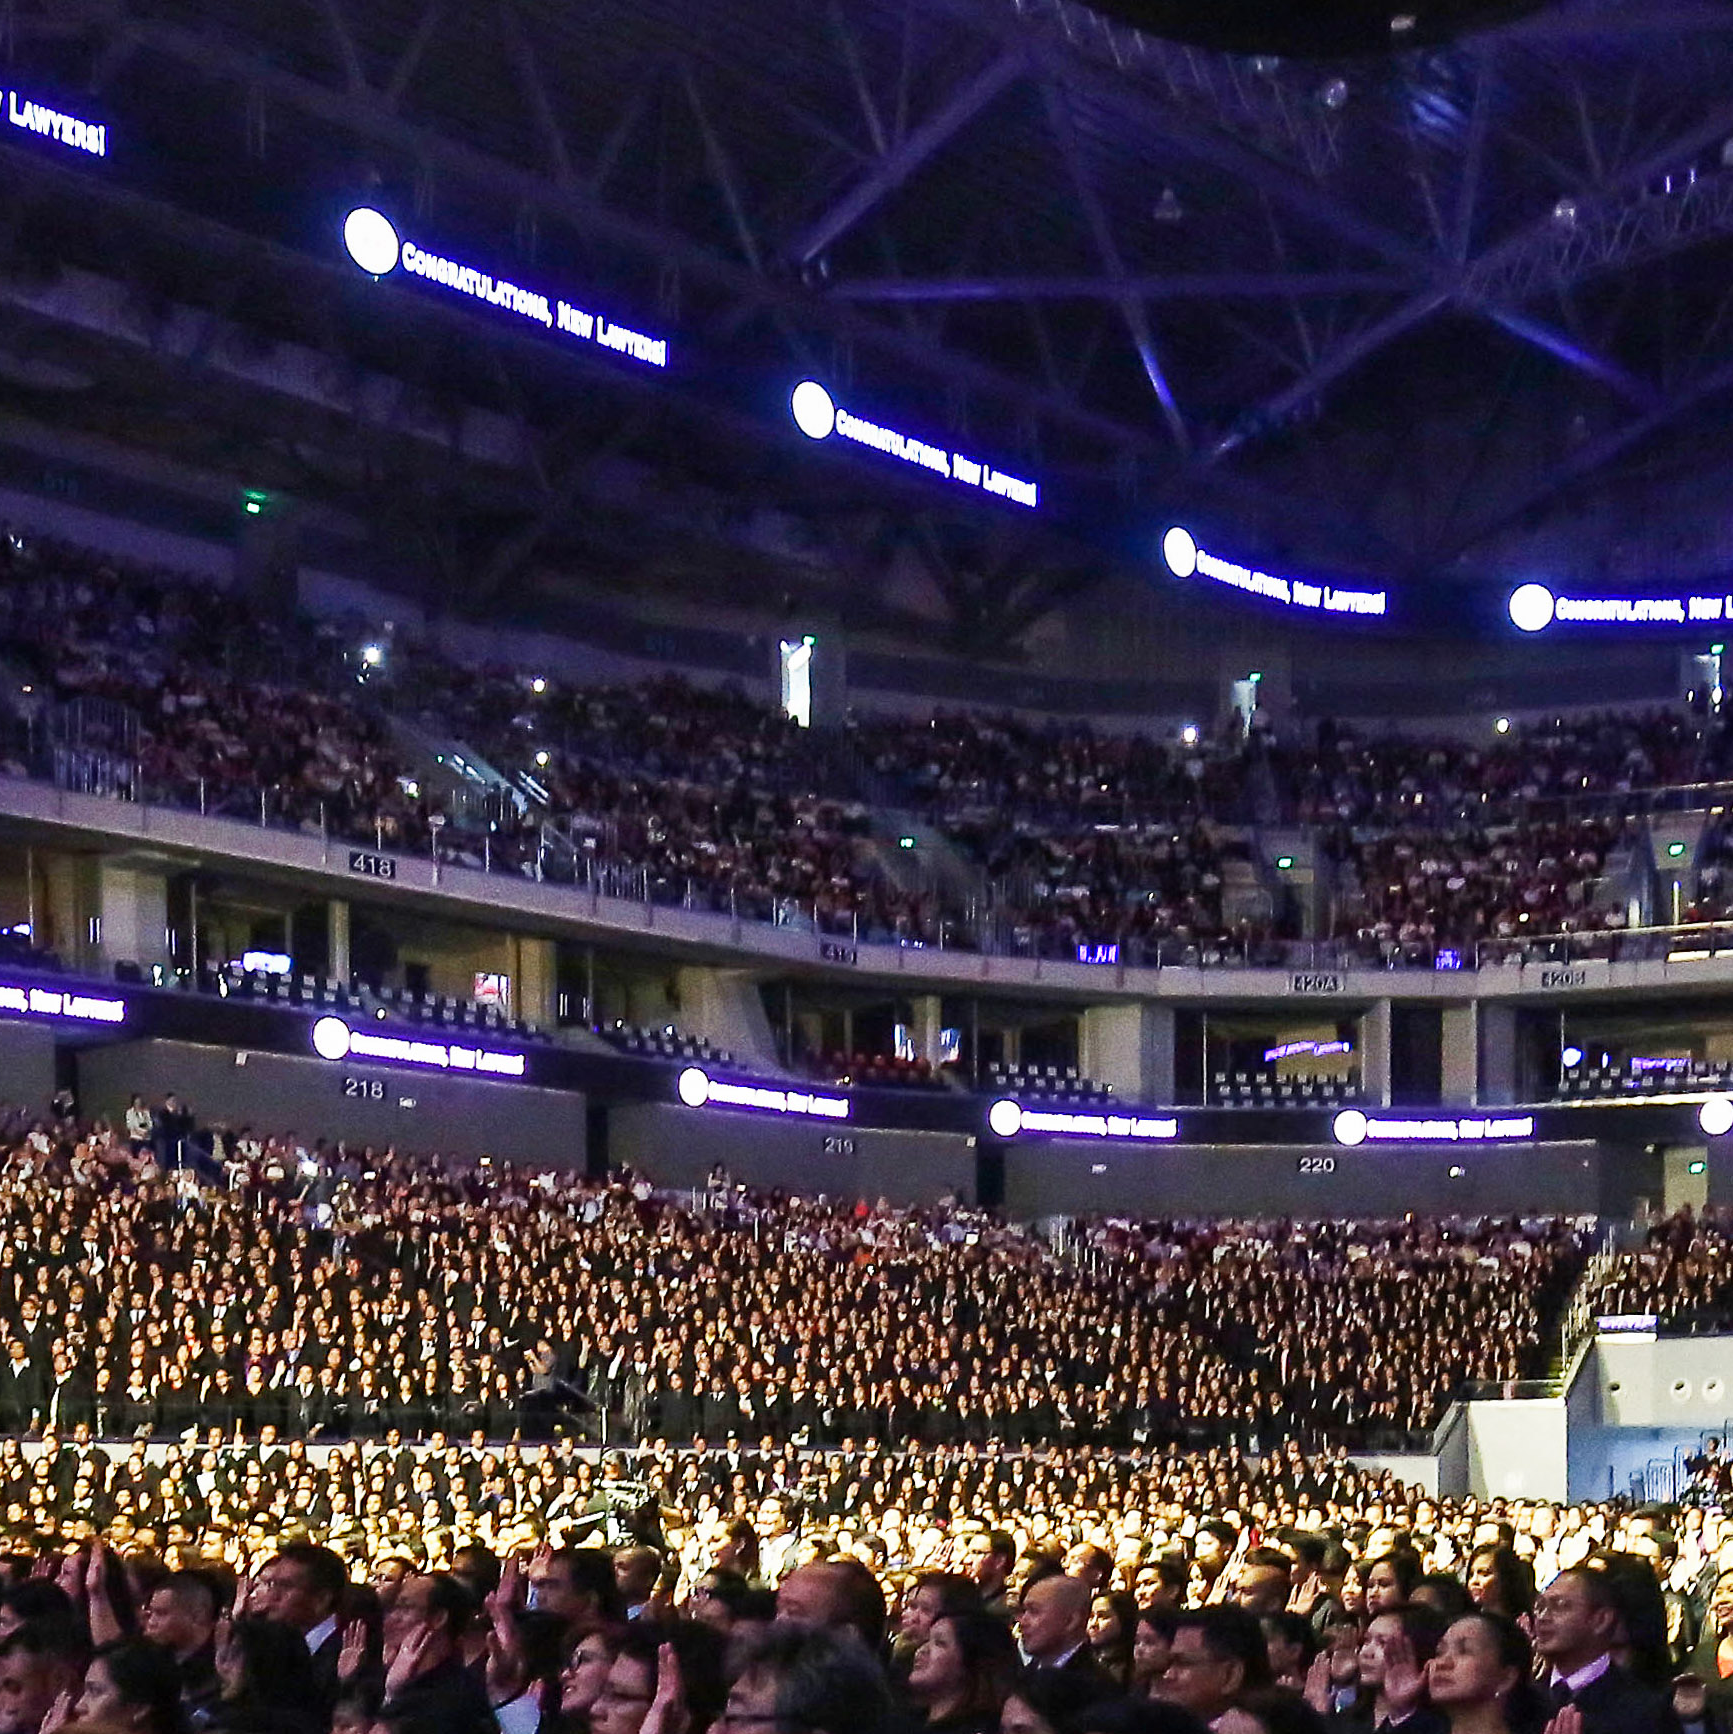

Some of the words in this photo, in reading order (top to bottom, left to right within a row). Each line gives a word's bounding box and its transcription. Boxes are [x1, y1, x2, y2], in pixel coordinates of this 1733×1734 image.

[353, 853, 391, 877] 418
[344, 1077, 384, 1099] 218
[1299, 1157, 1335, 1173] 220
